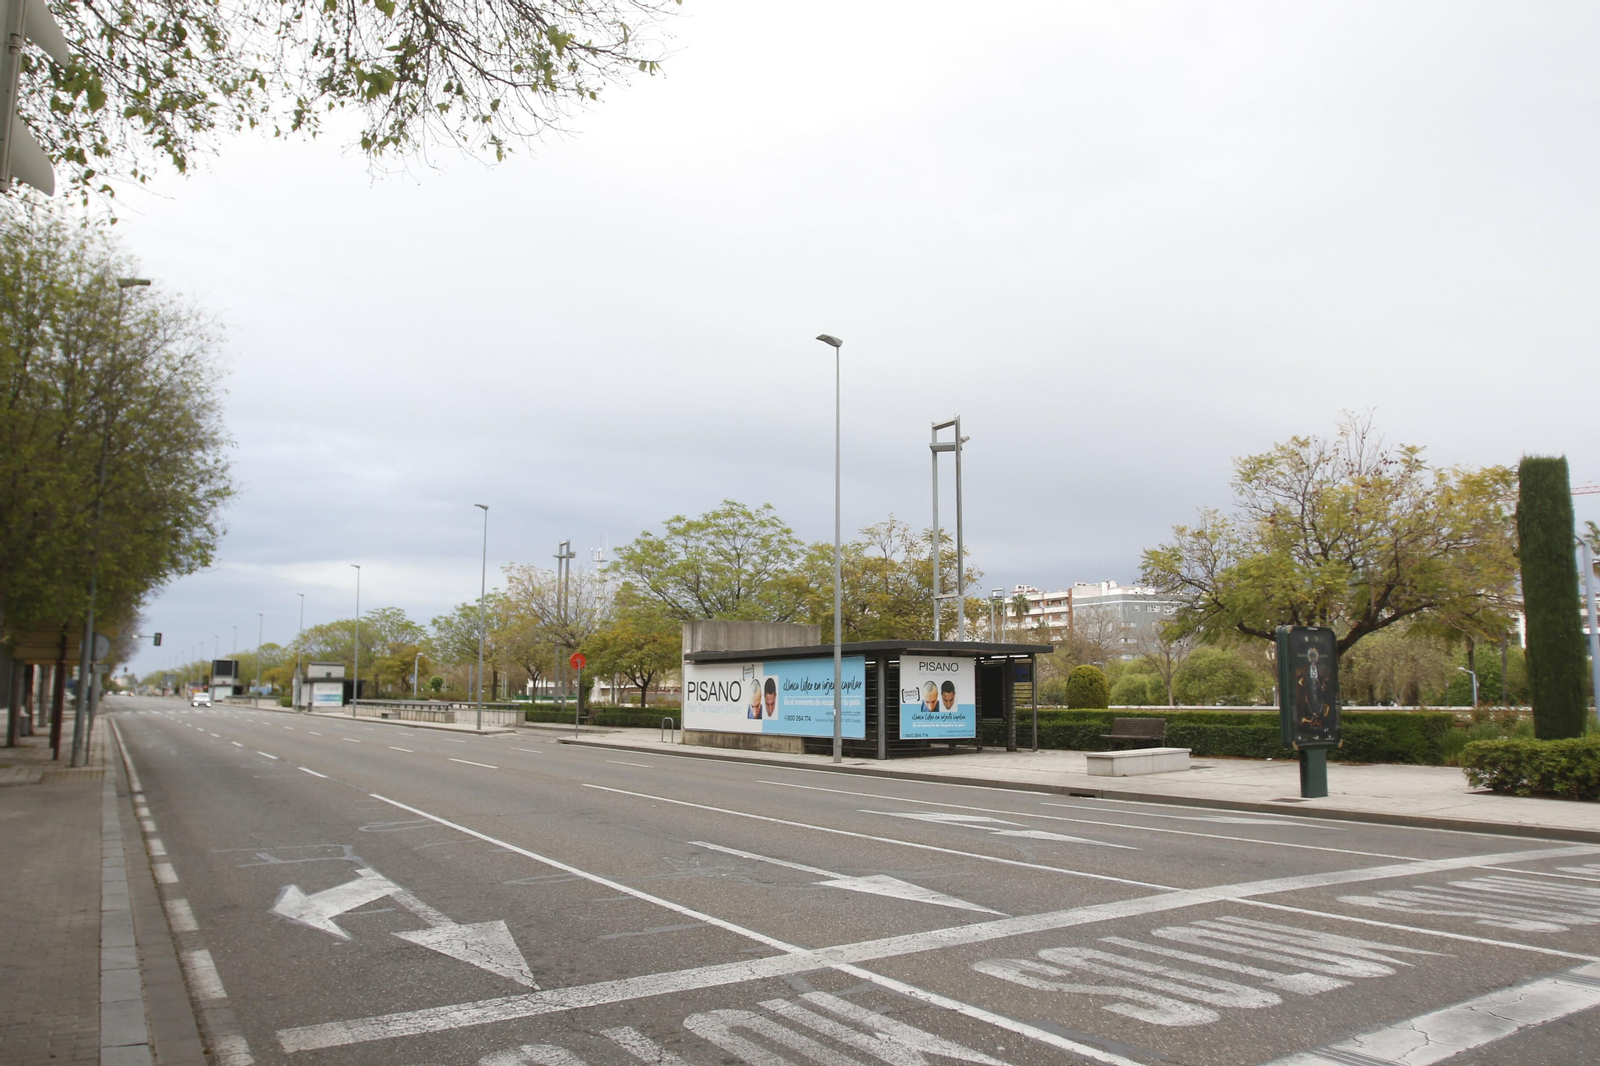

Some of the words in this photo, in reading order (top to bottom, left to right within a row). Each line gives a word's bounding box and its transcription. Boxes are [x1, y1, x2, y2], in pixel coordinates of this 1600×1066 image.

[919, 662, 959, 672] PISANO
[688, 681, 741, 702] PISANO
[841, 676, 862, 694] capilar
[971, 916, 1457, 1027] MOTOS
